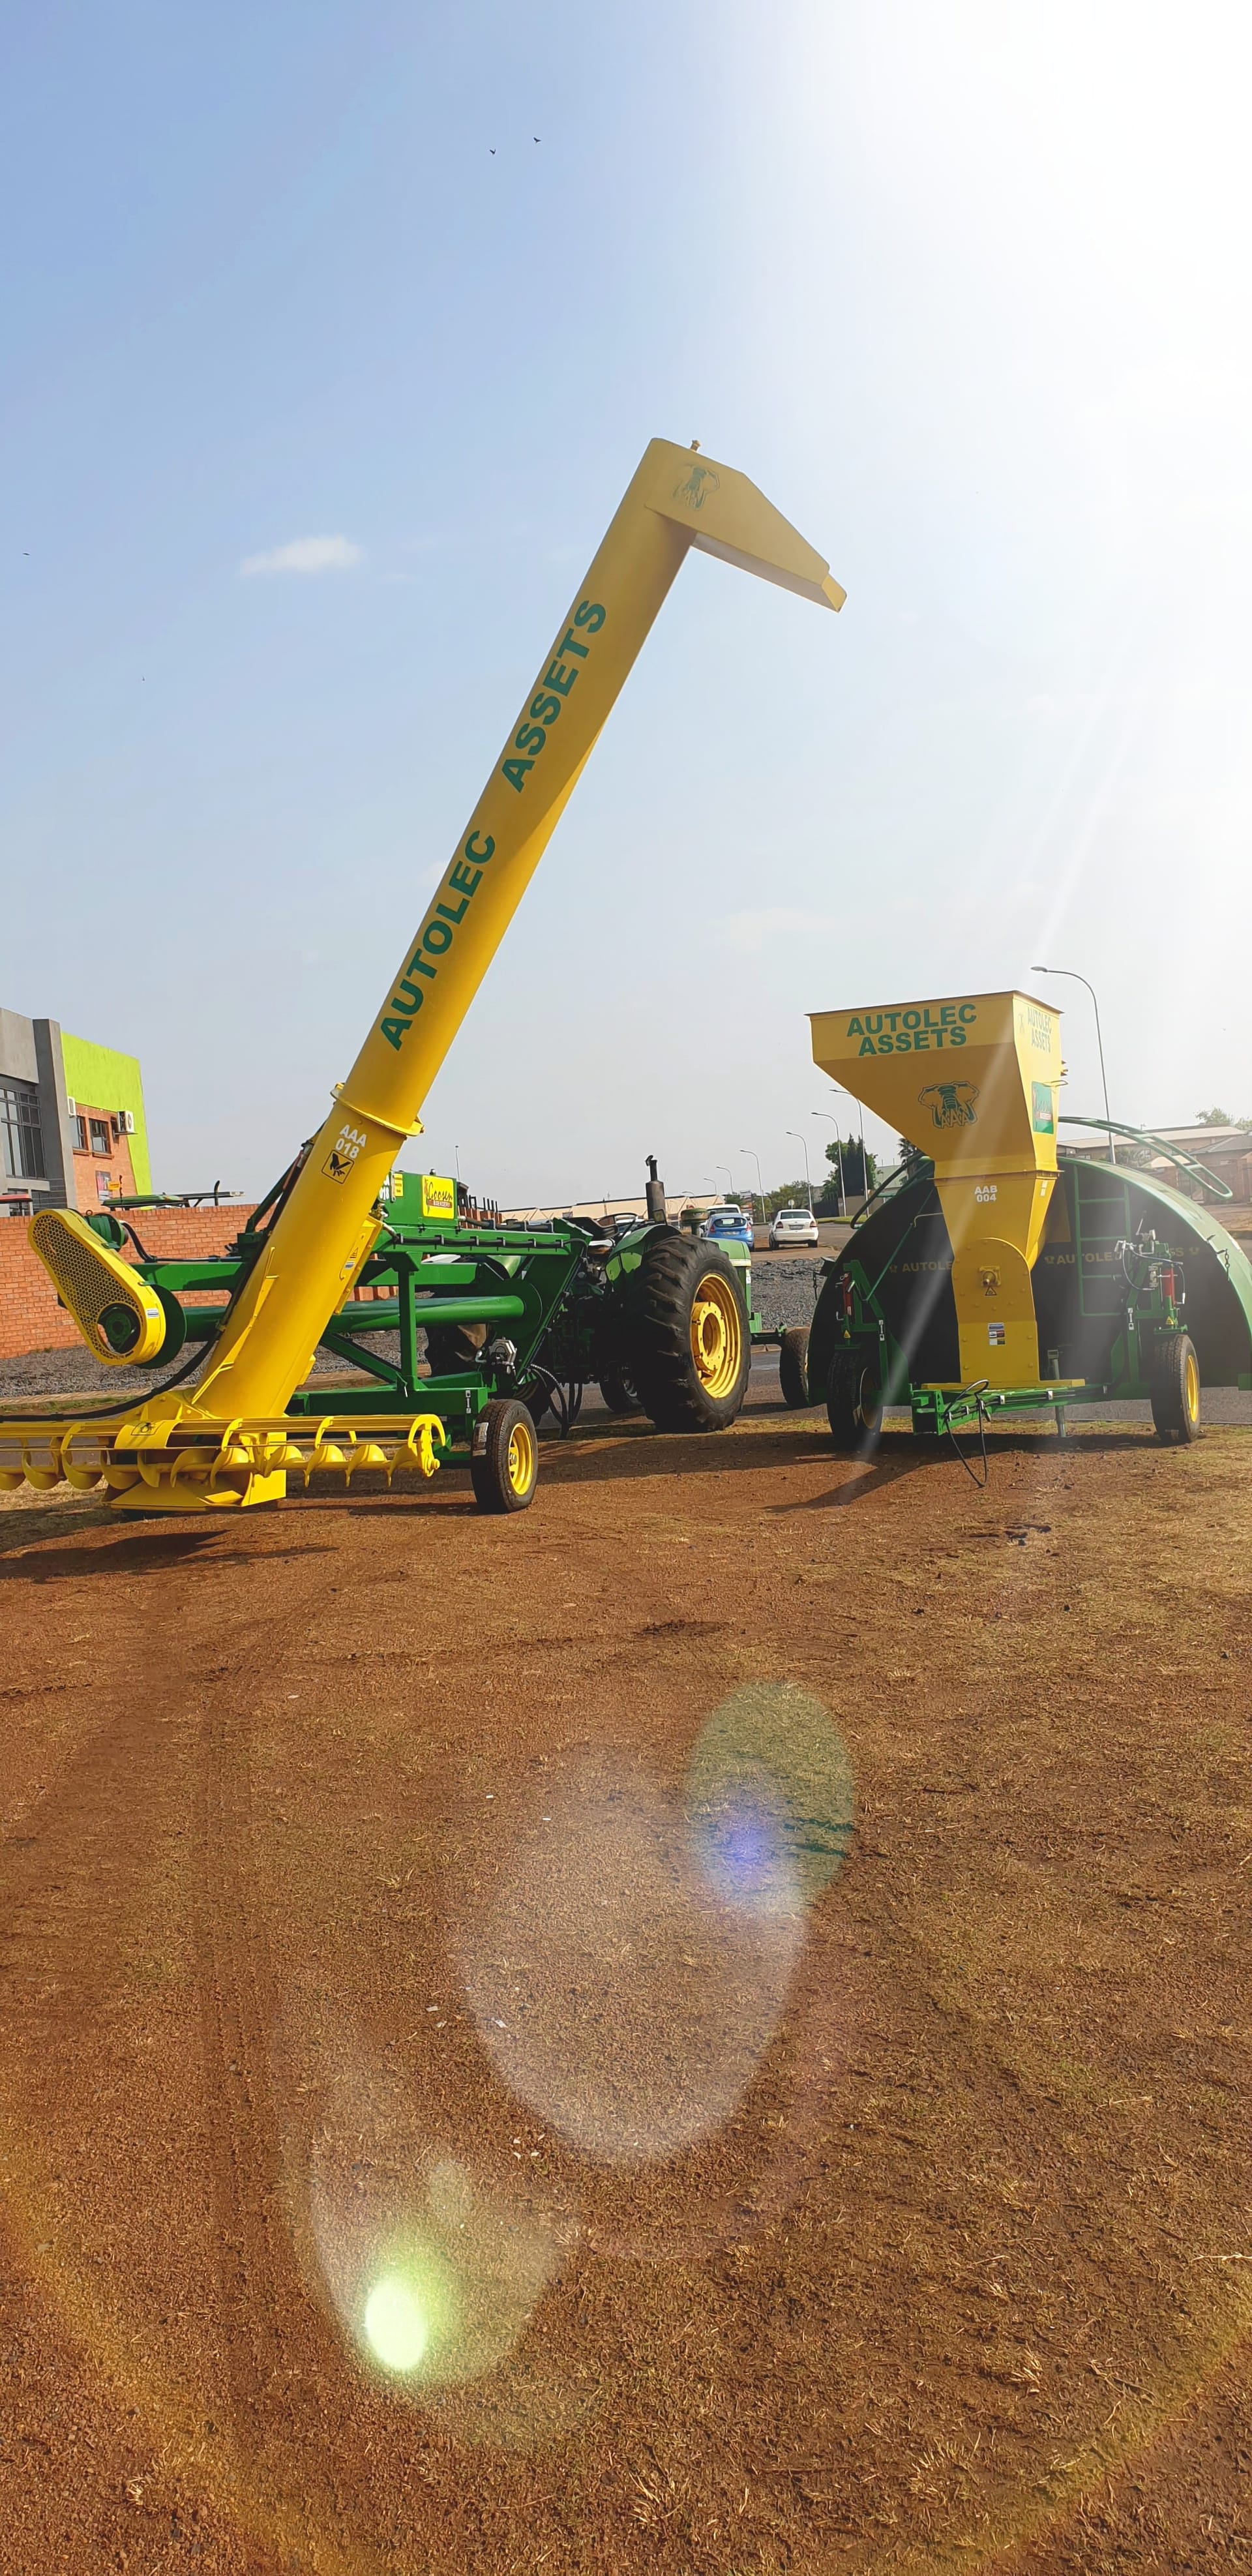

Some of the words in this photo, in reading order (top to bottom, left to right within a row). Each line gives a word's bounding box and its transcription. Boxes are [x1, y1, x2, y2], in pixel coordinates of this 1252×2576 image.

[380, 830, 496, 1051] AUTOLEC
[501, 600, 606, 793] ASSETS
[846, 1004, 977, 1037] AUTOLEC
[1028, 1006, 1052, 1034] AUTOLEC
[858, 1026, 966, 1056] ASSETS
[339, 1124, 366, 1148] AAA
[335, 1138, 359, 1159] 018
[974, 1185, 998, 1195] AAB
[976, 1193, 996, 1203] 004
[902, 1261, 952, 1272] AUTOLE
[1056, 1251, 1112, 1265] AUOLE
